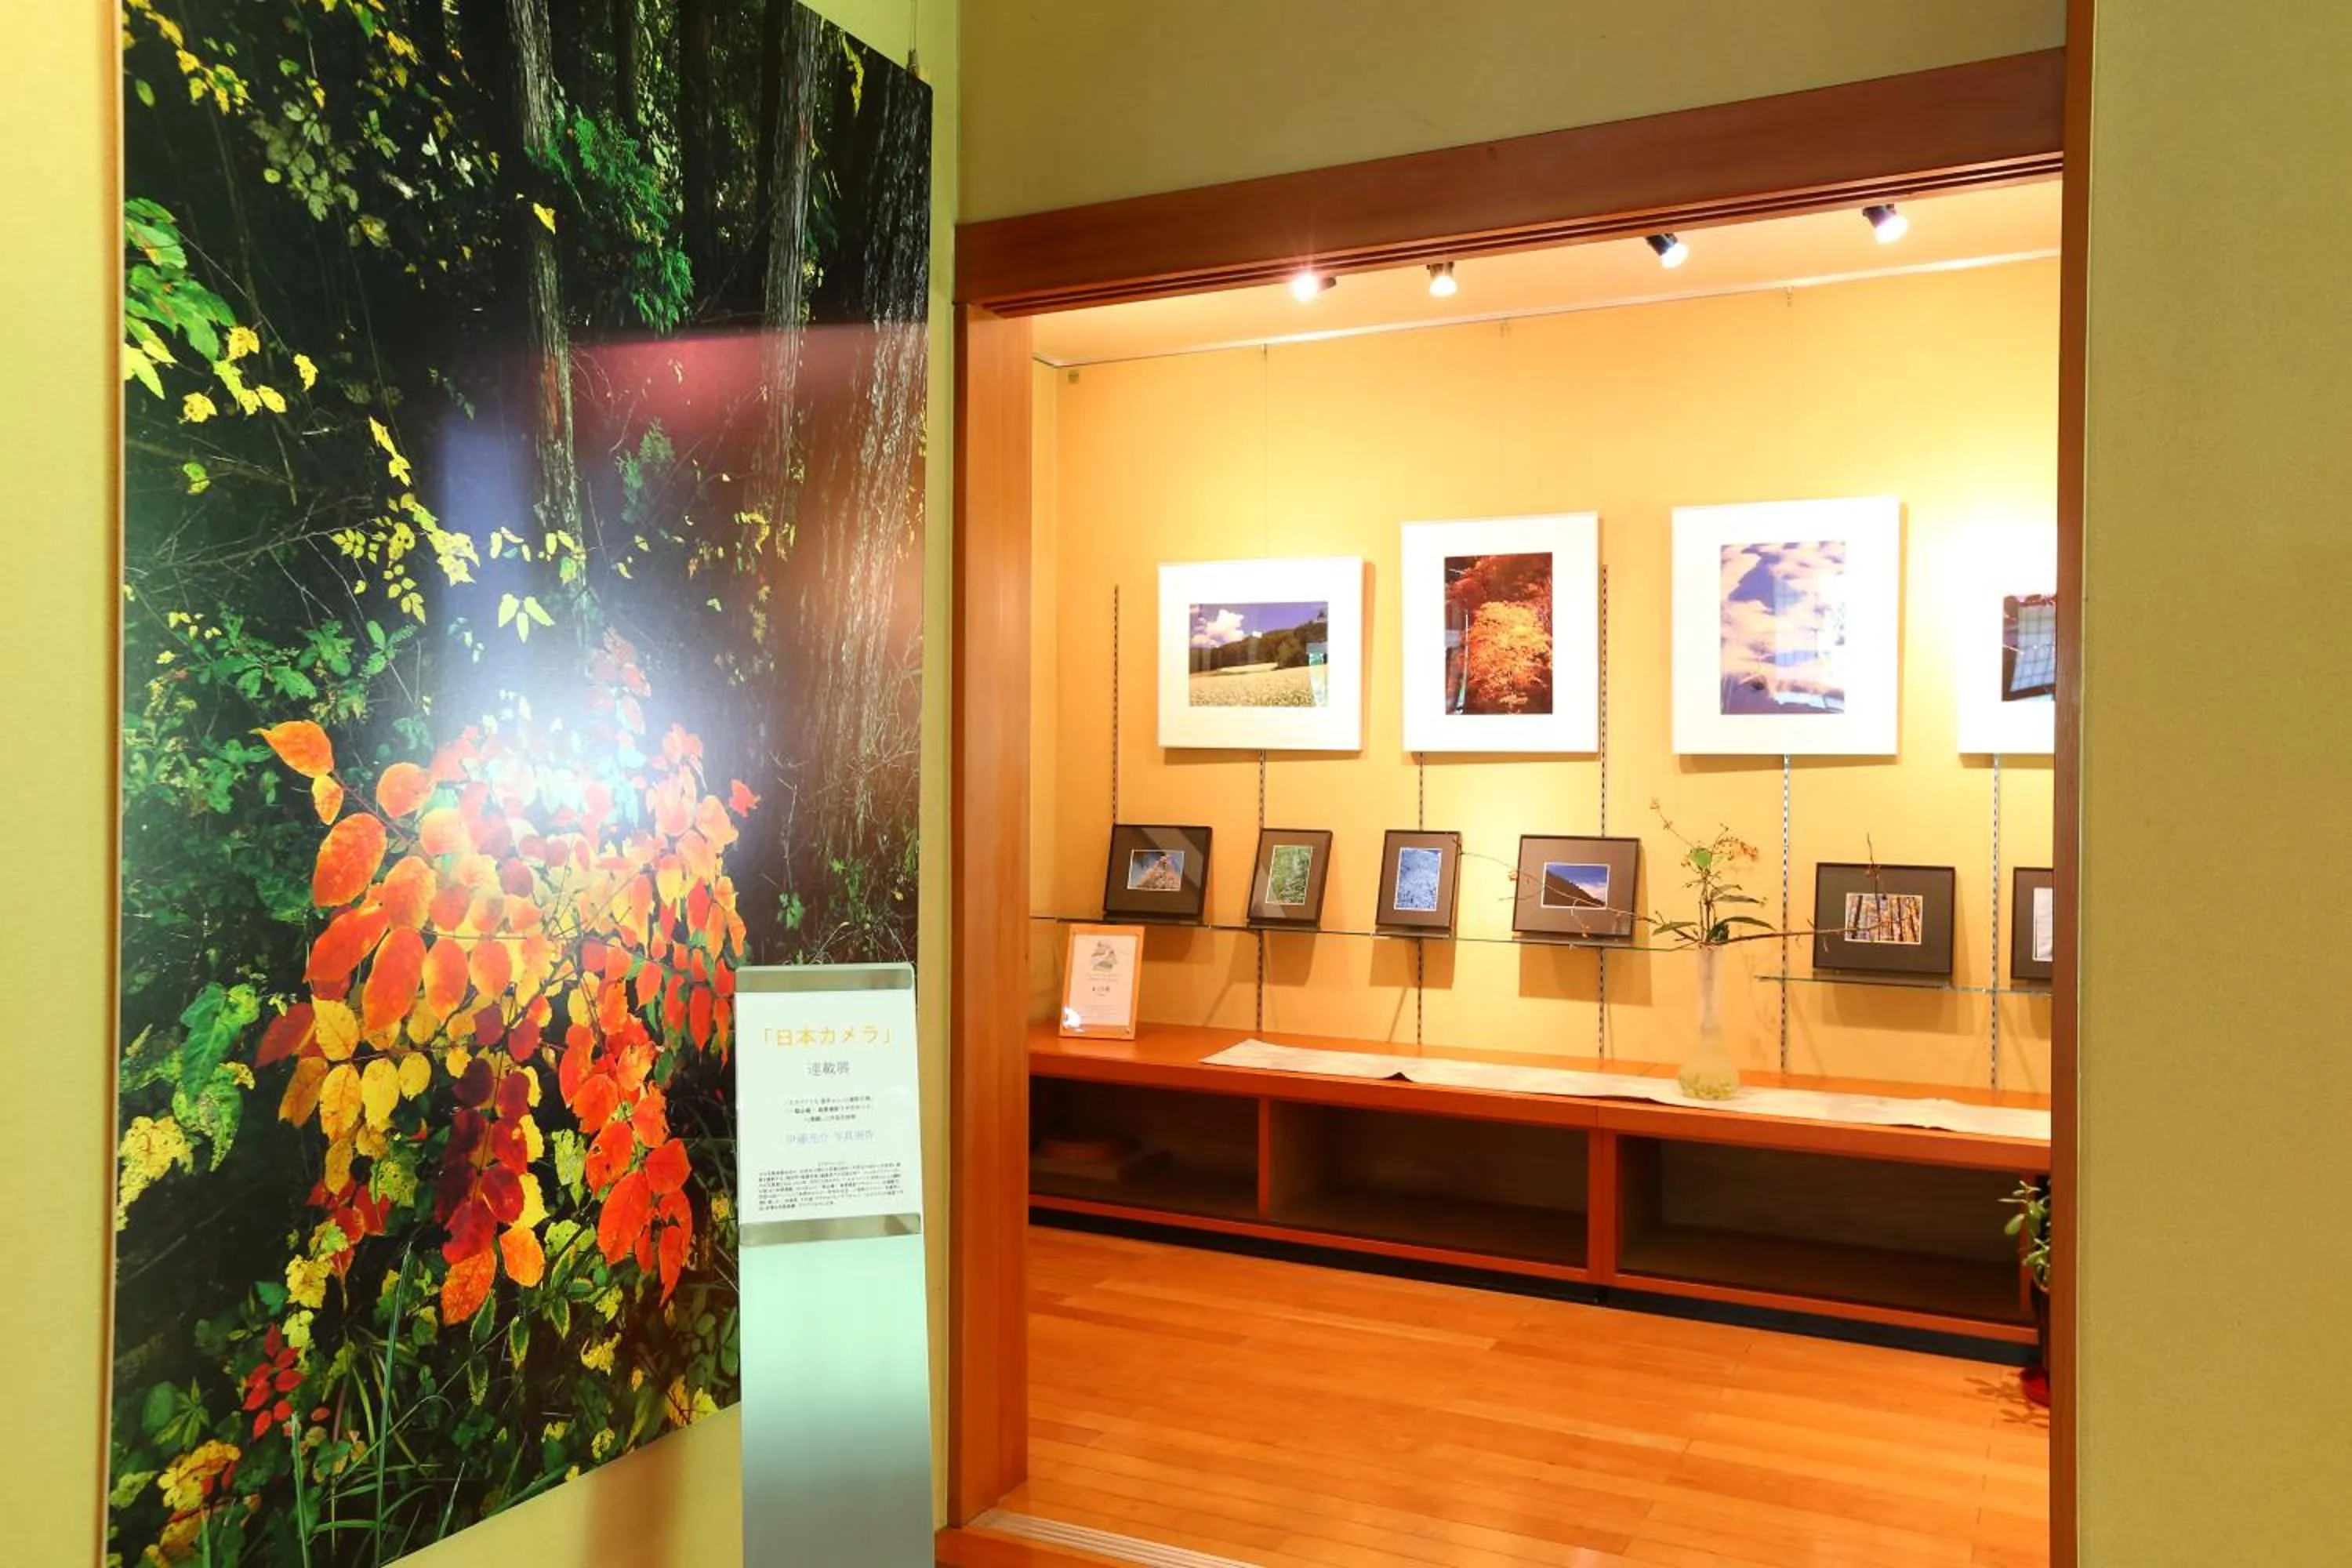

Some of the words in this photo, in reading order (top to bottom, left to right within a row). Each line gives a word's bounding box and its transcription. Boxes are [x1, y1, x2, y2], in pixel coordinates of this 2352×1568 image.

[764, 1025, 891, 1046] 「日本カメラ」
